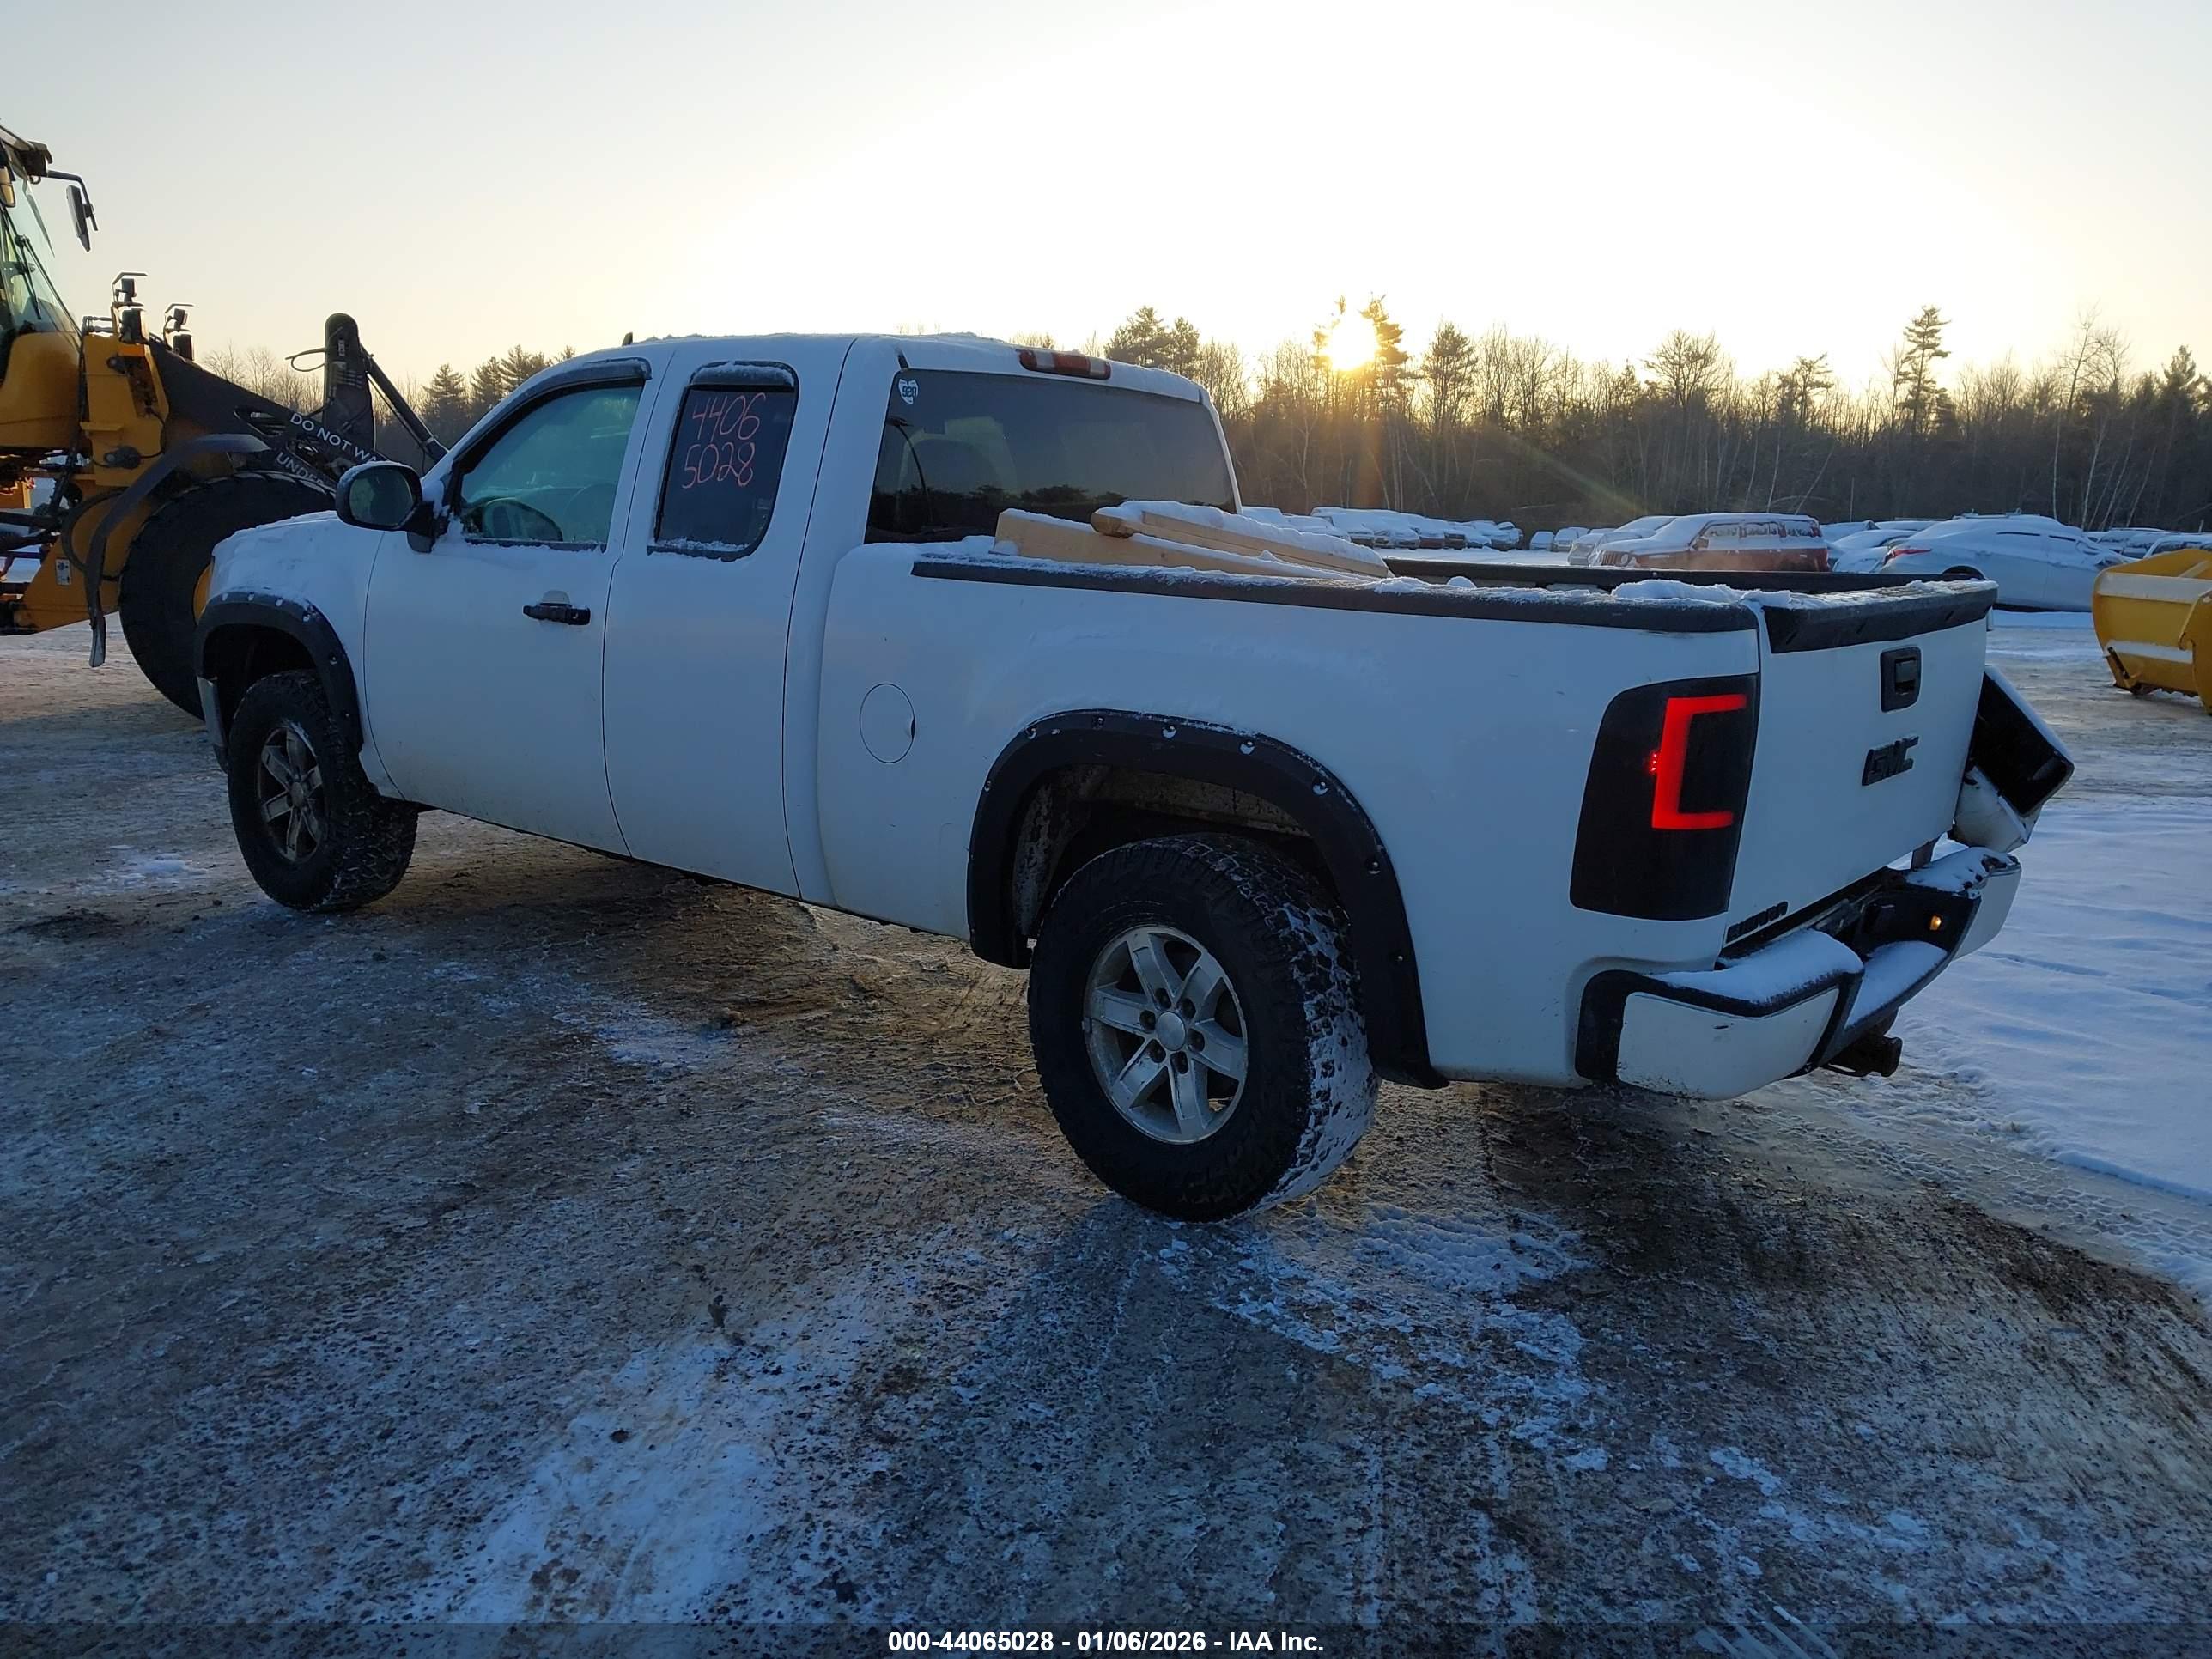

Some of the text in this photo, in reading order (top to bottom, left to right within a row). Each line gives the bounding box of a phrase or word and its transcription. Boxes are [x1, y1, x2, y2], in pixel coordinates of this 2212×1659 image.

[289, 412, 315, 432] DO
[316, 427, 352, 451] NOT
[692, 392, 766, 443] 4406
[682, 441, 756, 489] 5028
